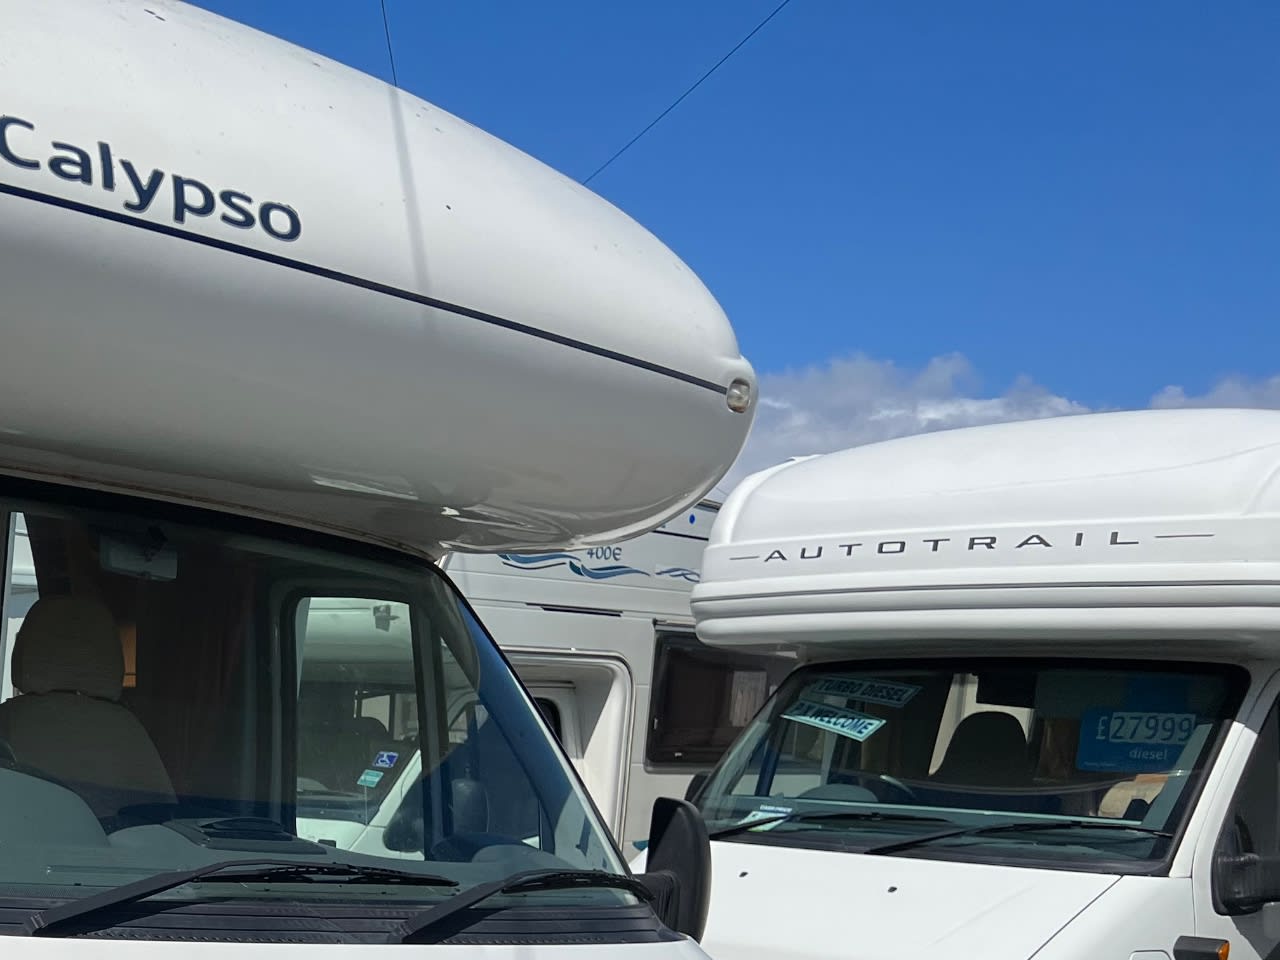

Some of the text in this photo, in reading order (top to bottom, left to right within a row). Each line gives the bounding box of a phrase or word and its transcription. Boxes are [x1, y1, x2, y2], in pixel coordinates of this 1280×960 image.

[763, 531, 1140, 562] AUTOTRAIL
[818, 678, 910, 702] TURBO DIESEL
[809, 707, 874, 735] WELCOME
[1128, 747, 1168, 760] diesel
